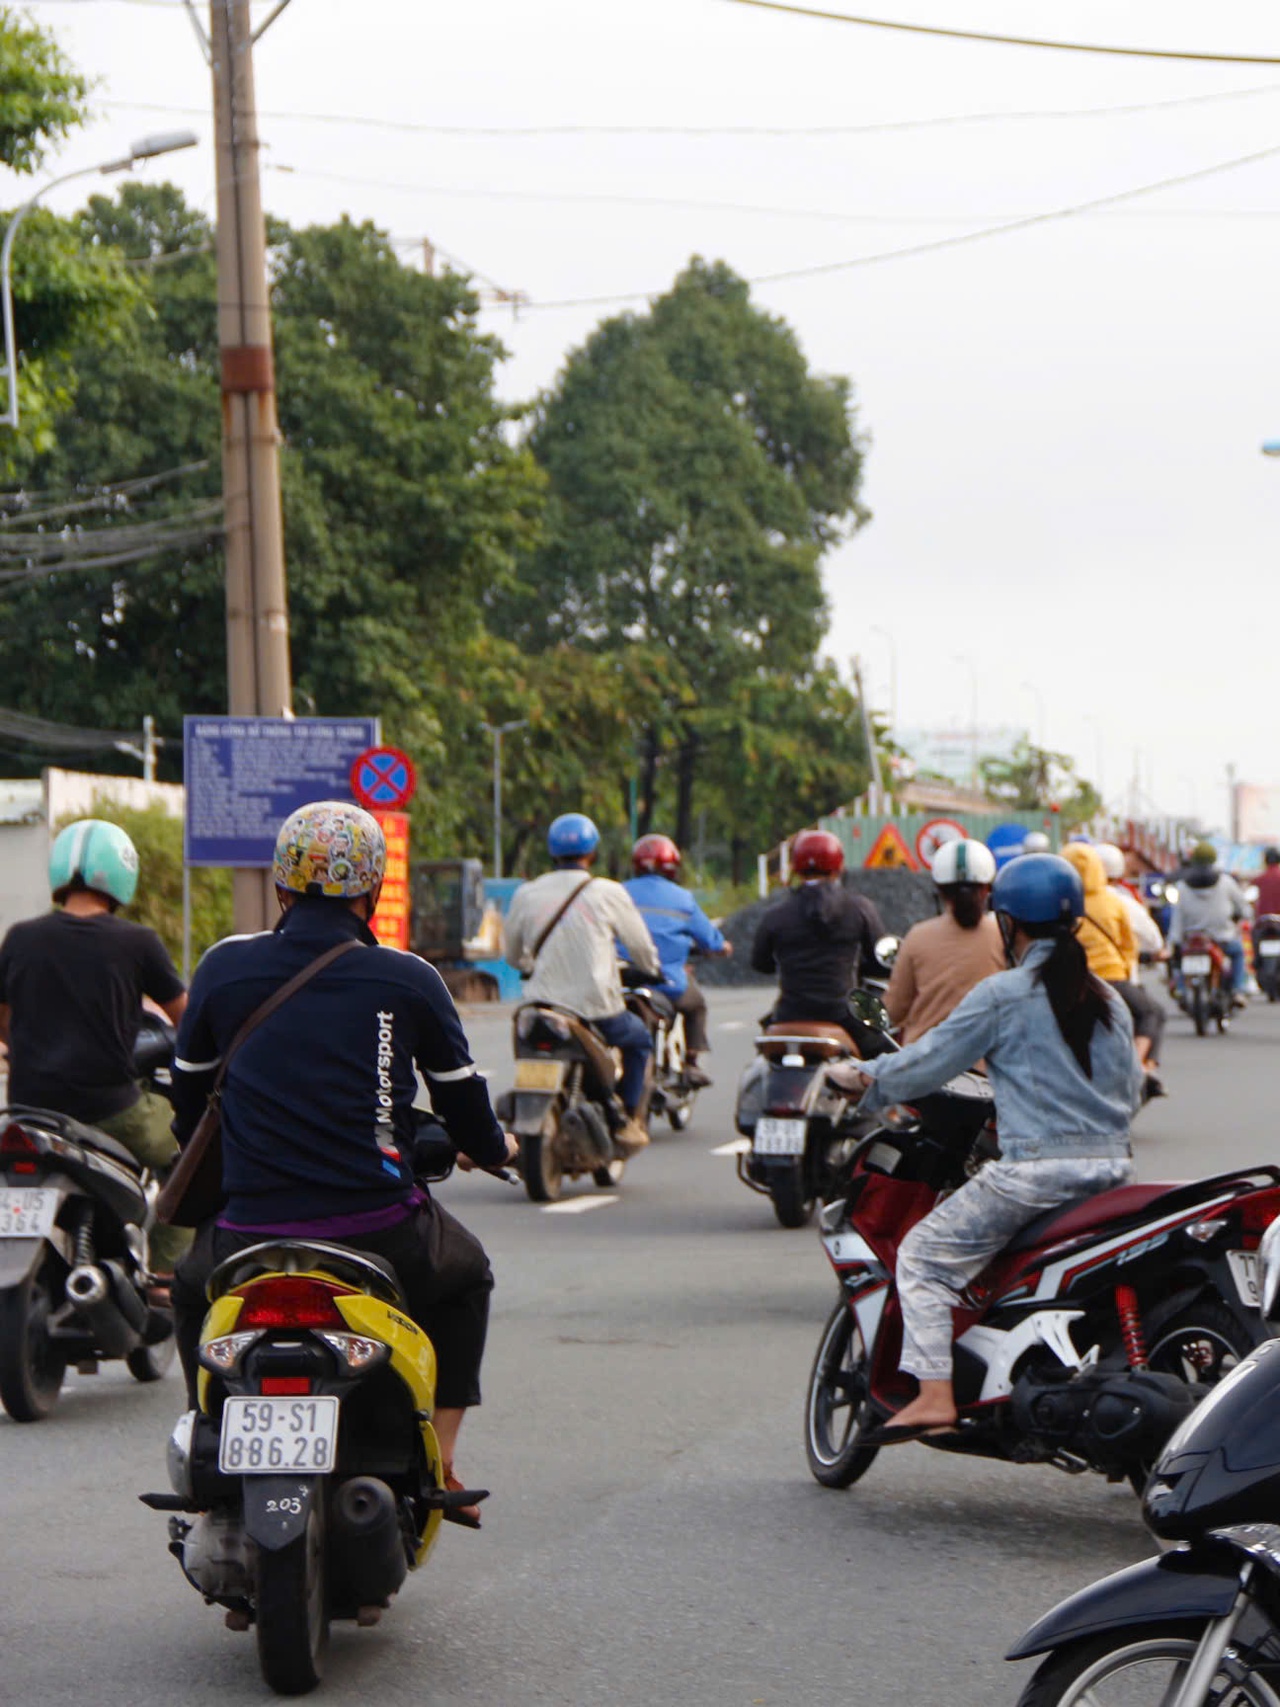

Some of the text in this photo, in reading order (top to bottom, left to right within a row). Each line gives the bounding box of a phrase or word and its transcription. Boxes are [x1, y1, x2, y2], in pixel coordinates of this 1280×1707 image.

[375, 1010, 395, 1124] Motorsport
[241, 1403, 318, 1433] 59-S1
[227, 1437, 329, 1467] 886.28
[265, 1497, 302, 1515] 203
